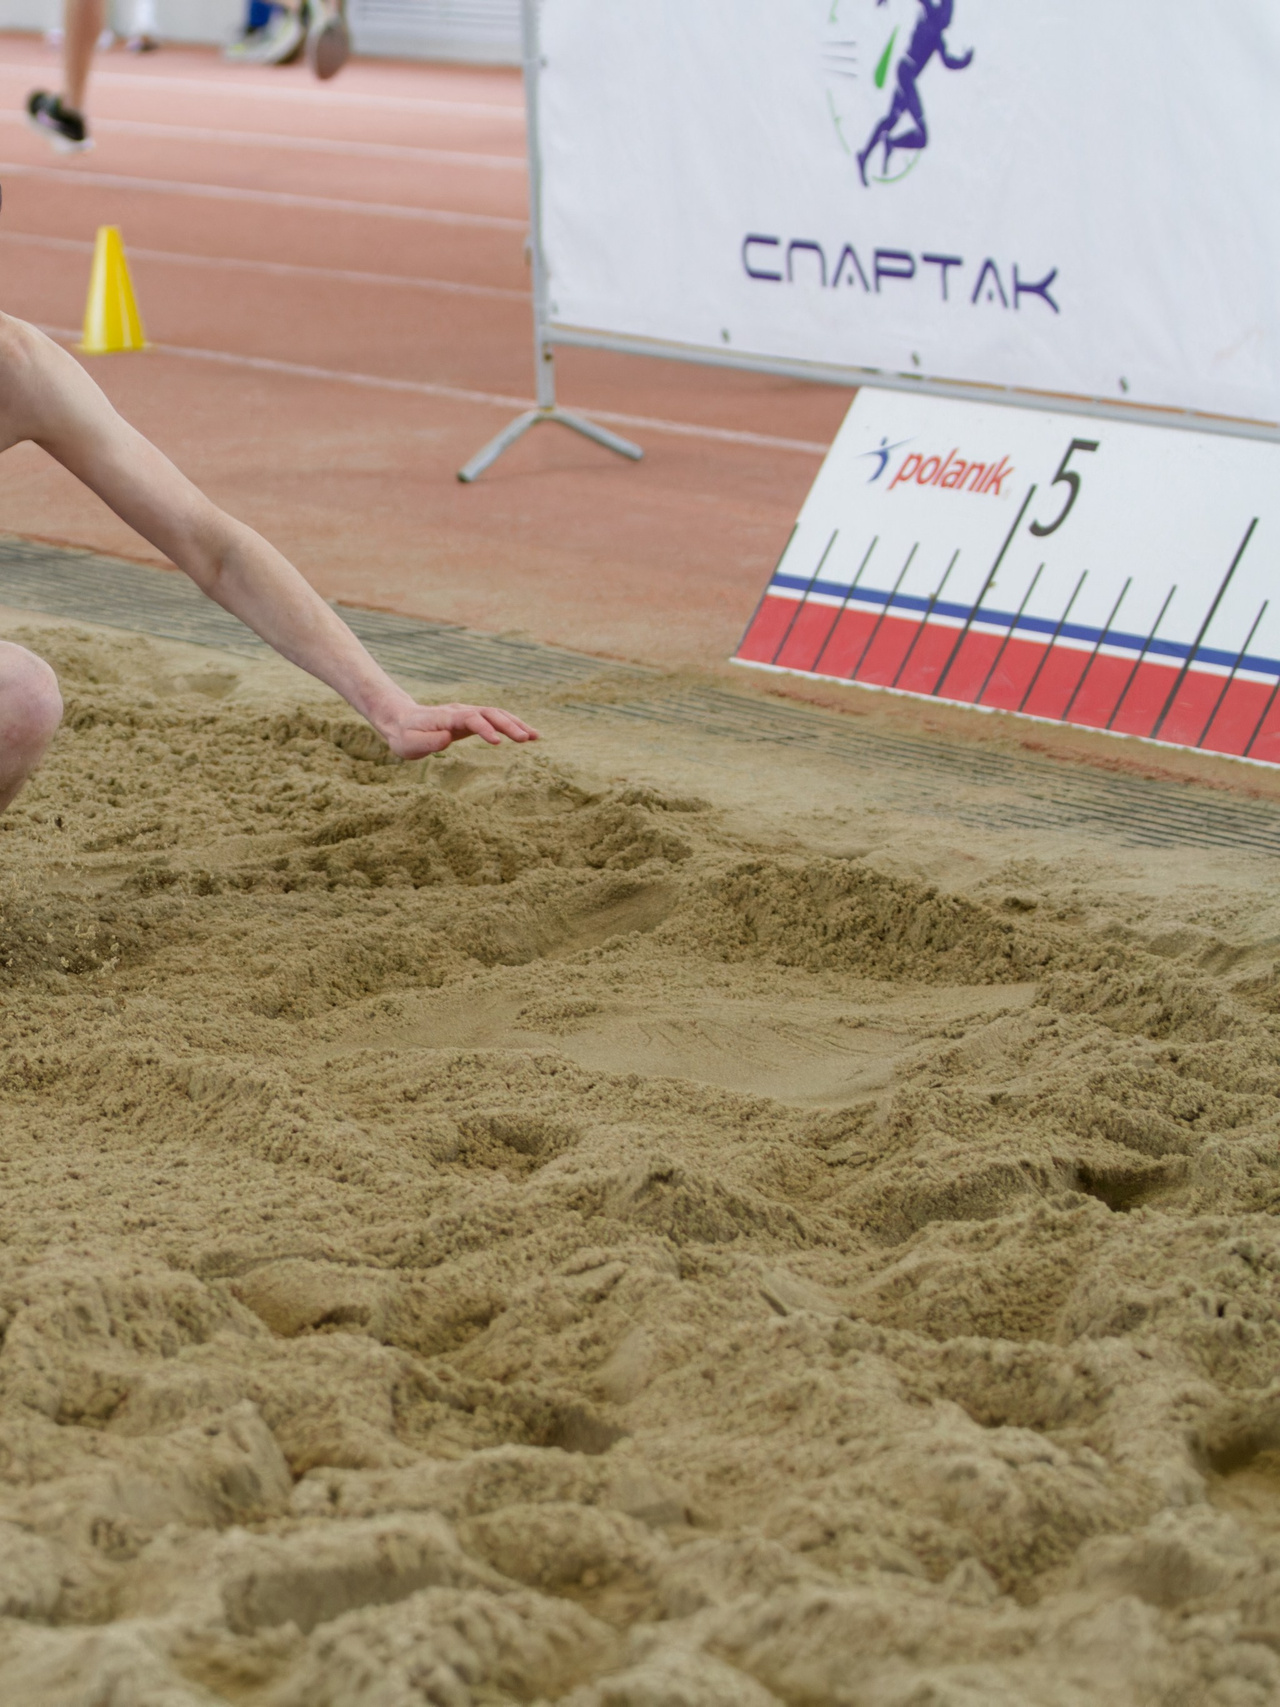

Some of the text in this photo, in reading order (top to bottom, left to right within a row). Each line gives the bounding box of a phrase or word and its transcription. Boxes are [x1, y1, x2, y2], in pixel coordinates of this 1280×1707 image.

[742, 234, 1060, 314] СПАРТАК
[887, 438, 1100, 537] polanik 5
